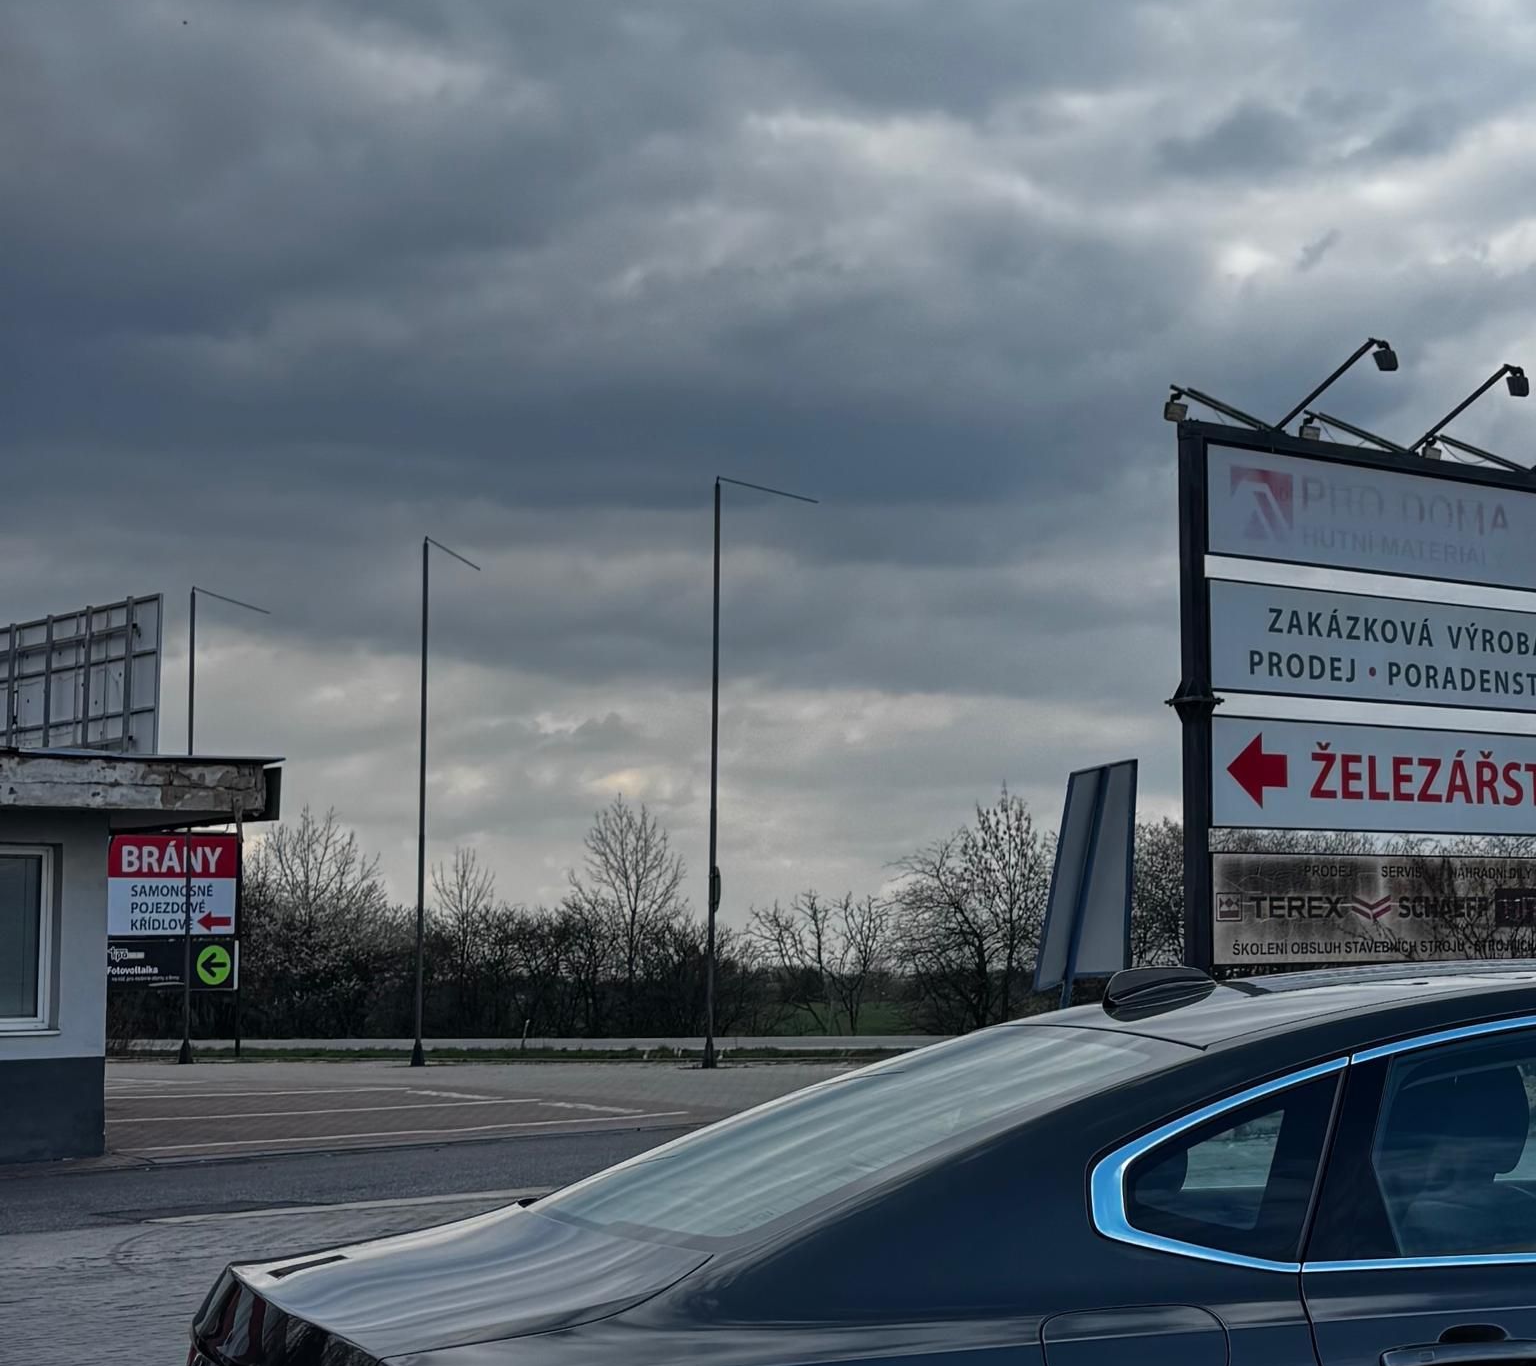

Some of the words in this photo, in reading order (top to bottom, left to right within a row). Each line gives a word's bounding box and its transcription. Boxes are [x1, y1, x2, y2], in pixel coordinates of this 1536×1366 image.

[1268, 608, 1433, 647] ZAKÁZKOVÁ
[1249, 650, 1356, 683] PRODEJ
[122, 840, 223, 873] BRÁNY
[1304, 865, 1353, 878] PRODEJ
[1381, 866, 1423, 878] SERVIS
[130, 884, 214, 897] SAMONOSNÉ
[1250, 896, 1348, 919] TEREX
[1232, 939, 1288, 956] ŠKOLENÍ
[1290, 941, 1341, 955] OBSLUH
